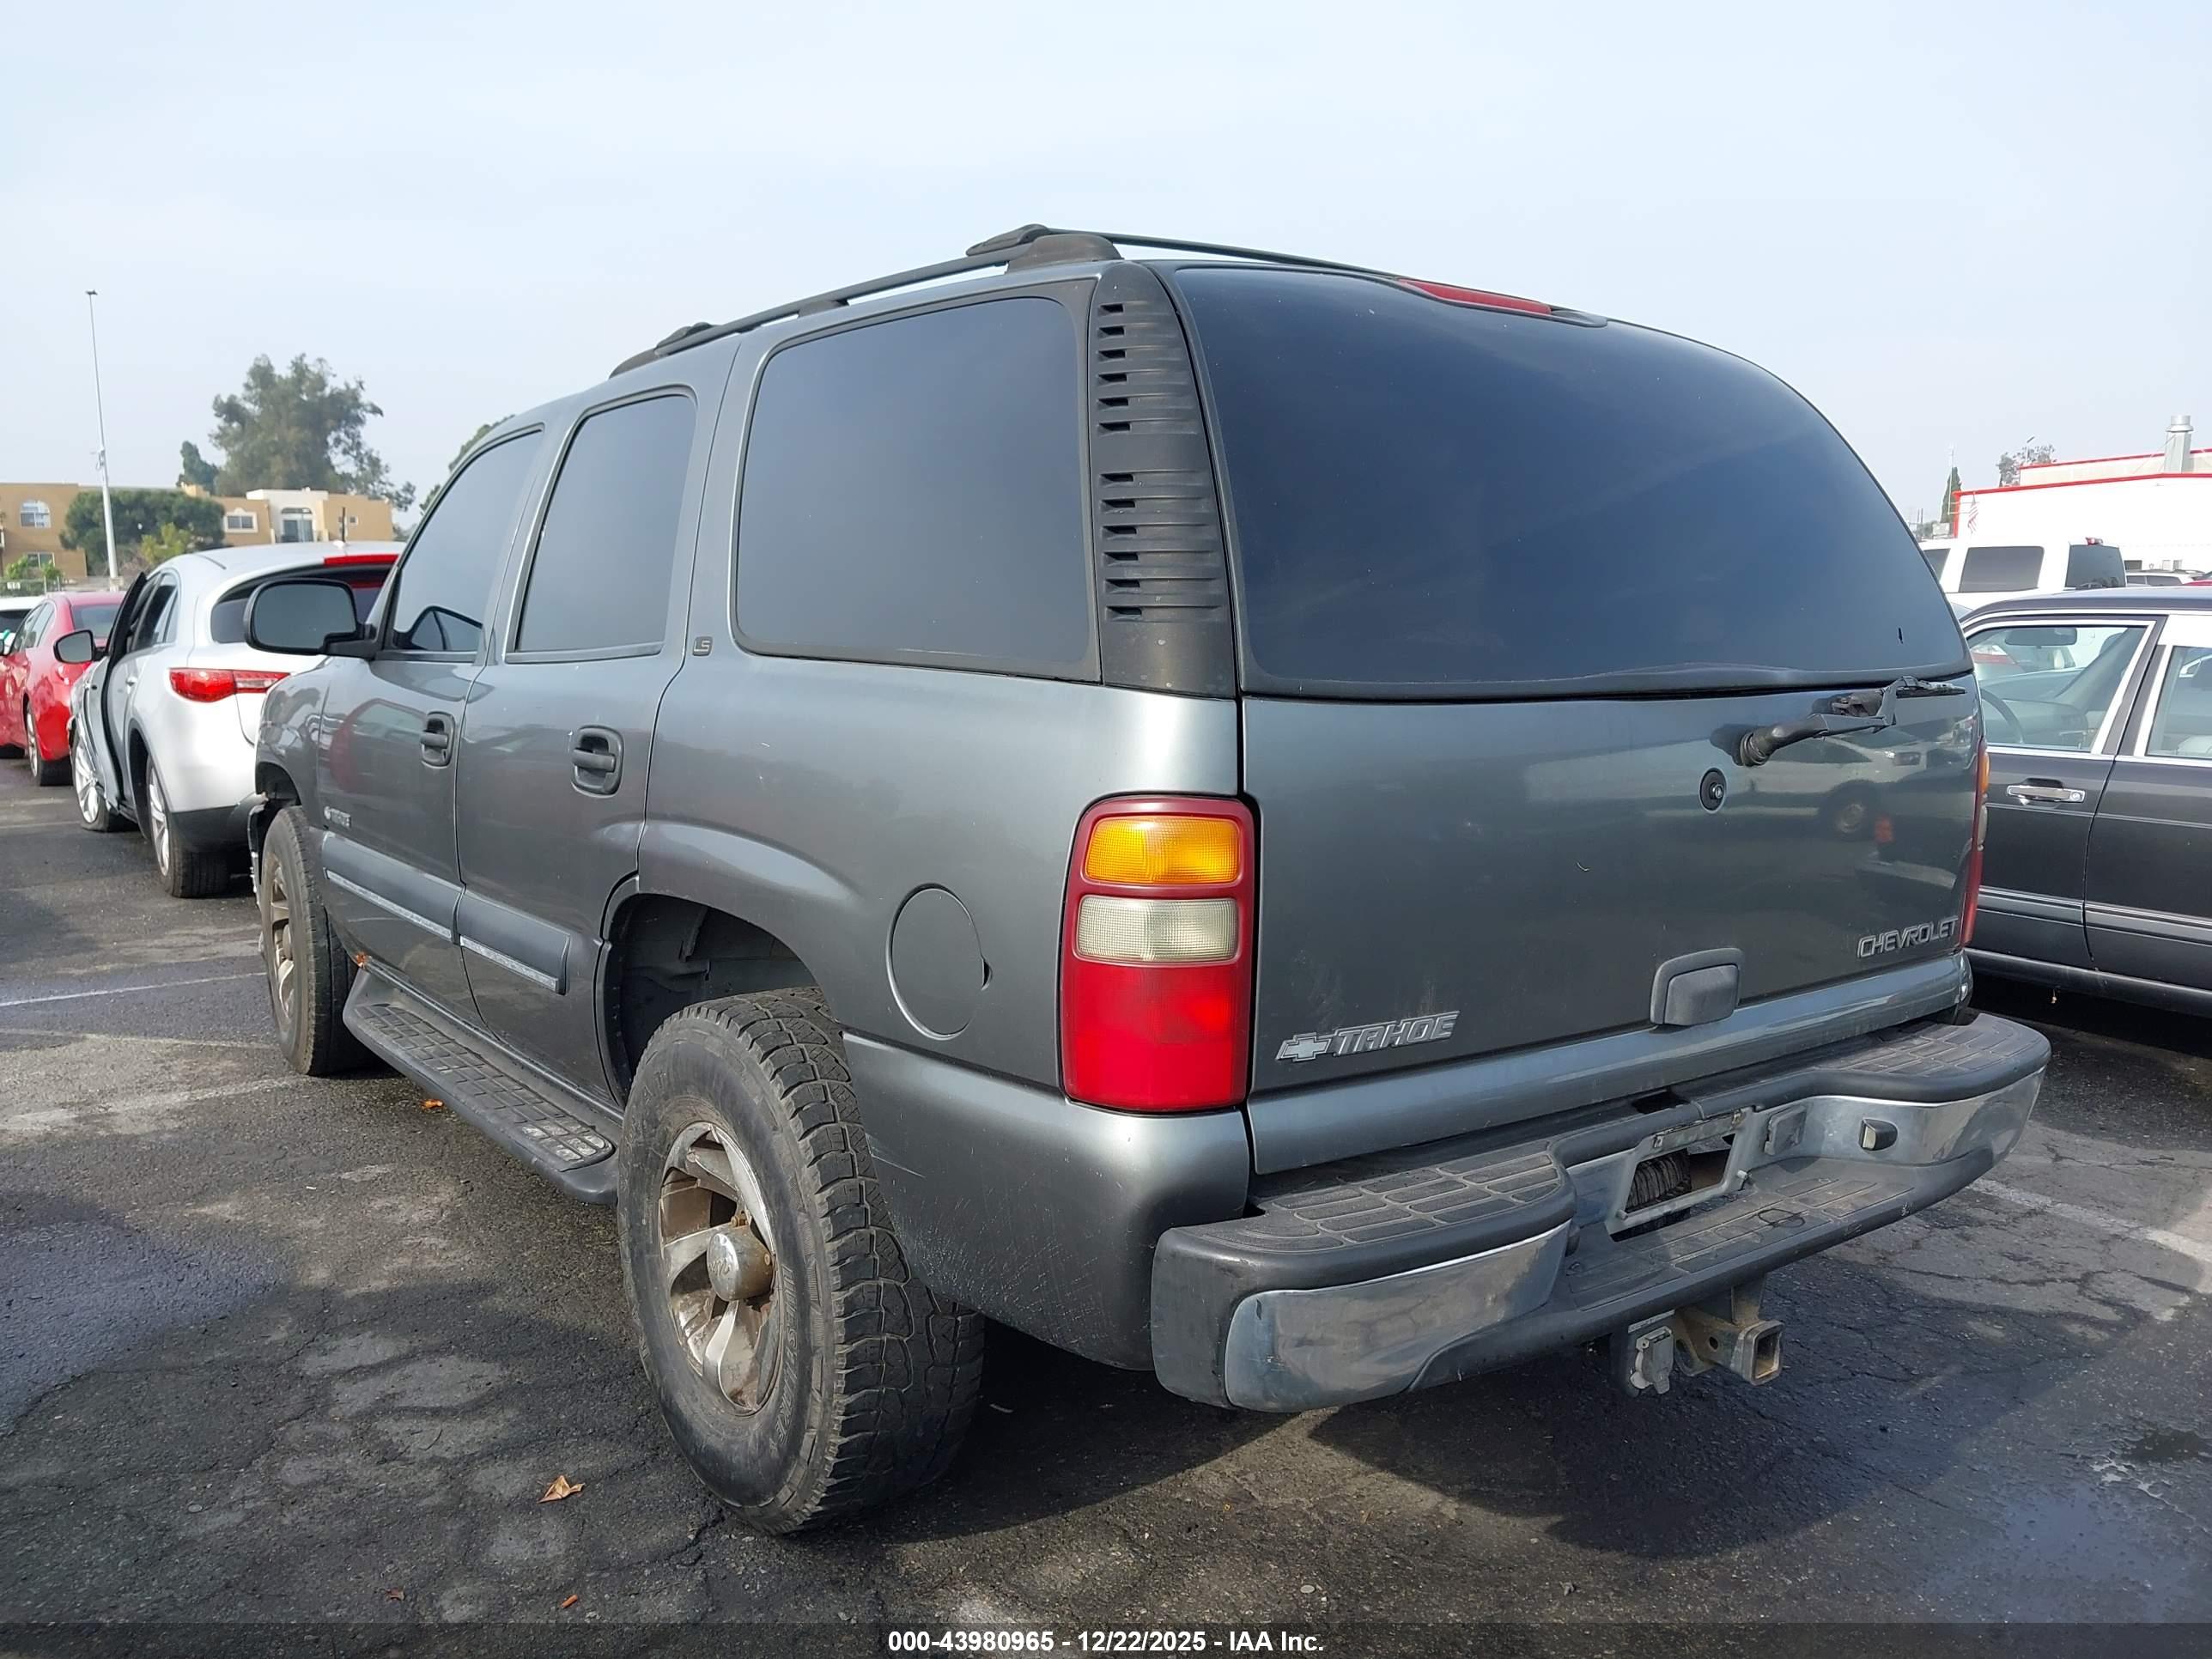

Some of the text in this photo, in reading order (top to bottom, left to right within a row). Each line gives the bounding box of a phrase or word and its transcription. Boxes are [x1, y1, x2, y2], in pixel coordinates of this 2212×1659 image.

[693, 639, 711, 652] LS
[1856, 915, 1959, 958] CHEVROLET
[1334, 1012, 1459, 1056] TAHOE
